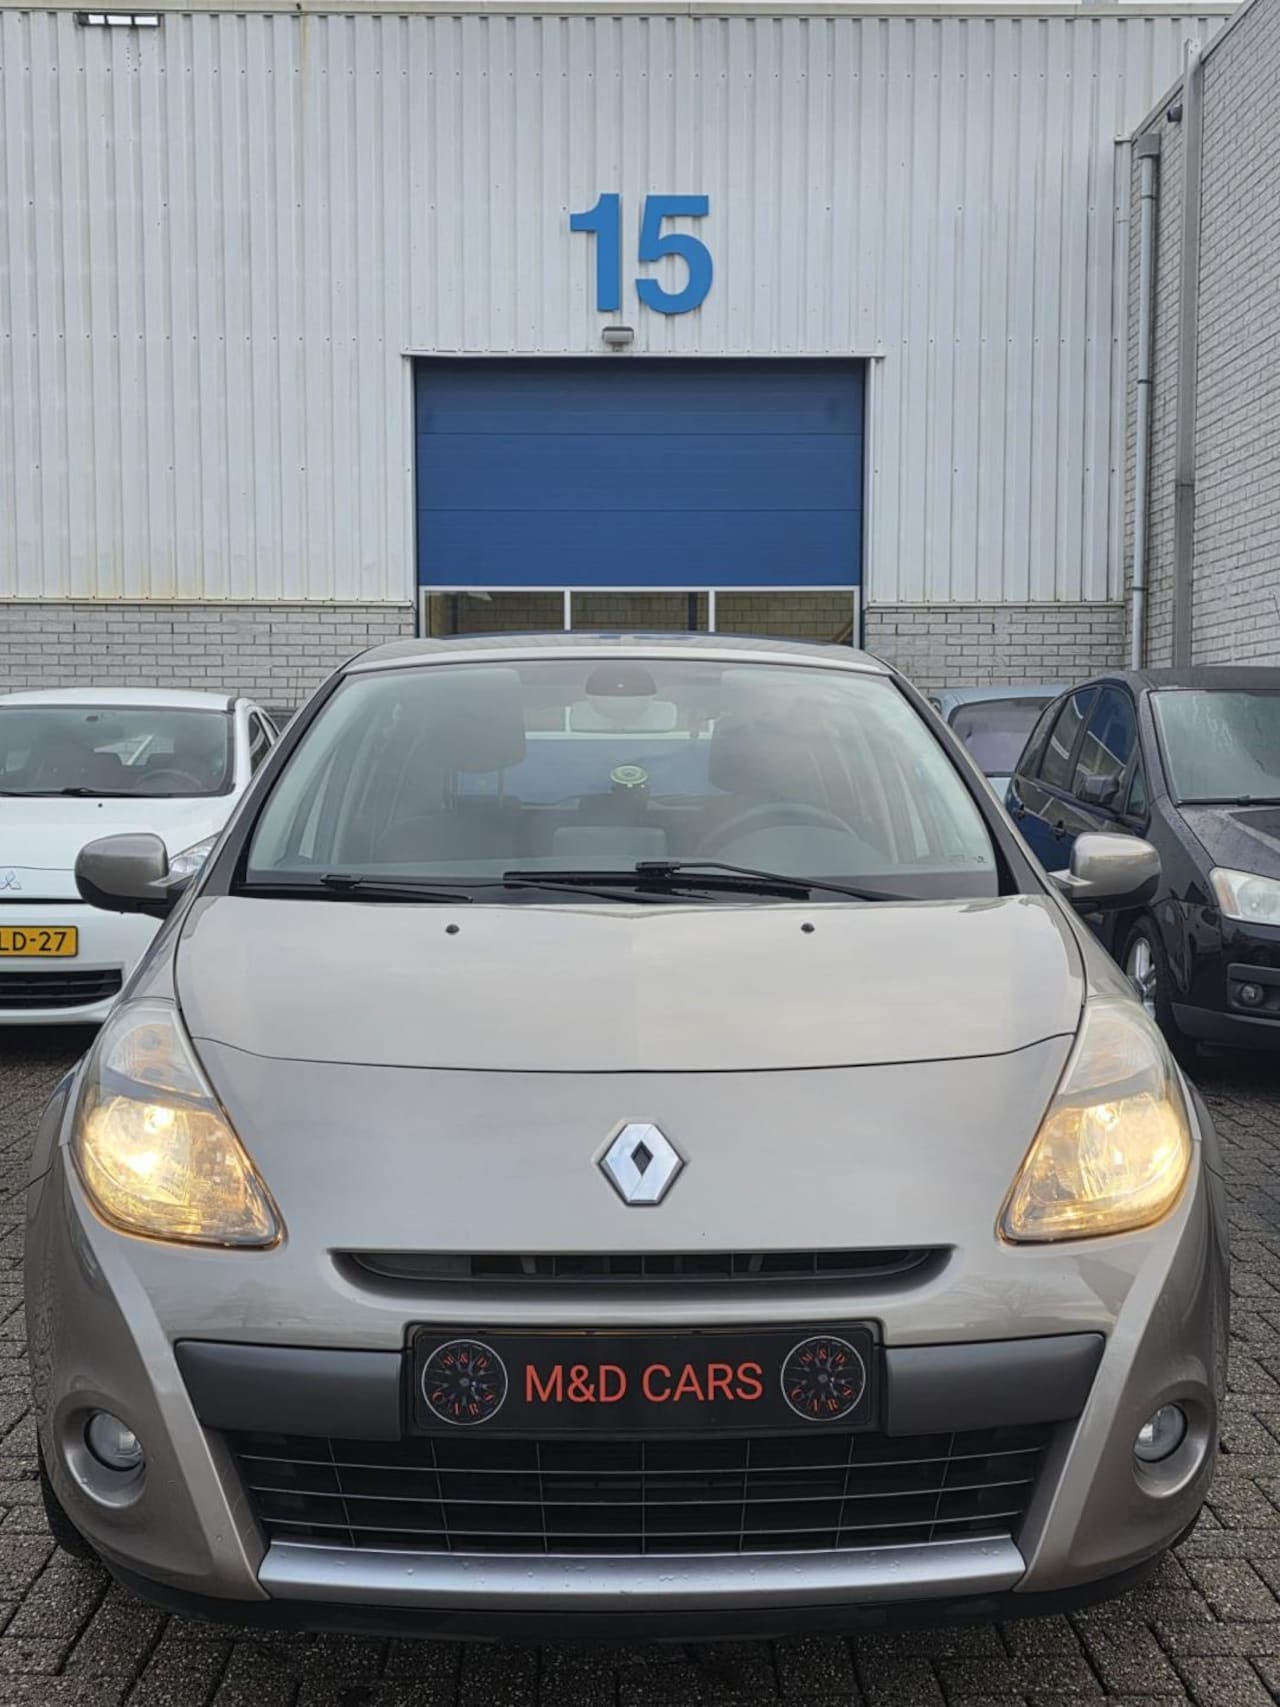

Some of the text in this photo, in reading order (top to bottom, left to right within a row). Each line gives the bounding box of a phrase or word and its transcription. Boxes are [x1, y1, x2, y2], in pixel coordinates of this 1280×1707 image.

[570, 193, 713, 315] 15
[525, 1362, 763, 1402] M&D CARS
